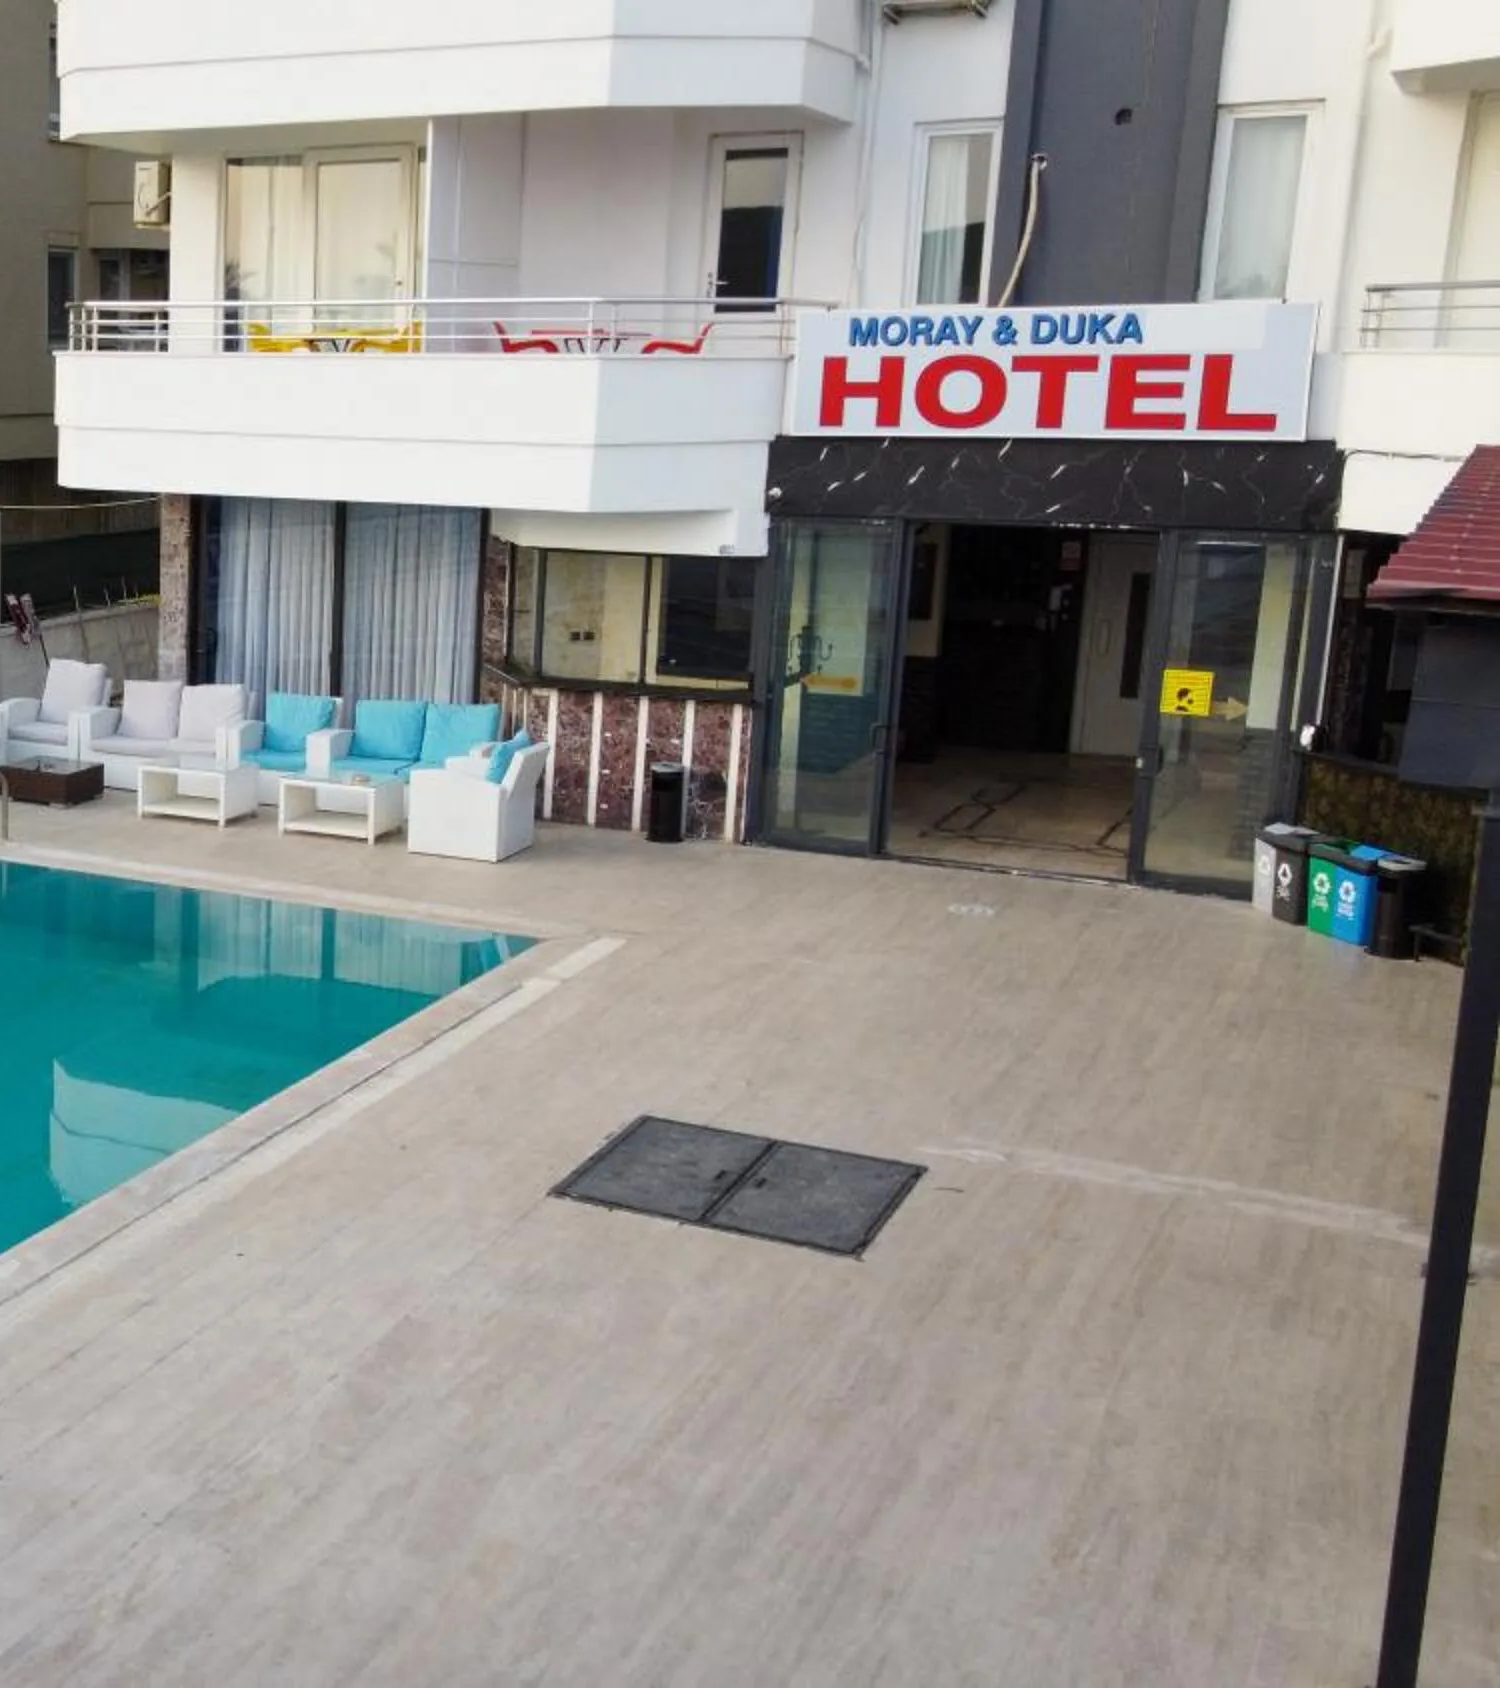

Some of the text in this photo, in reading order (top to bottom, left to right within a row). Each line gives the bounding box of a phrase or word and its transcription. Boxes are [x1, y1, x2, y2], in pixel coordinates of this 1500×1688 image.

[848, 311, 1143, 347] MORAY & DUKA
[819, 353, 1278, 432] HOTEL
